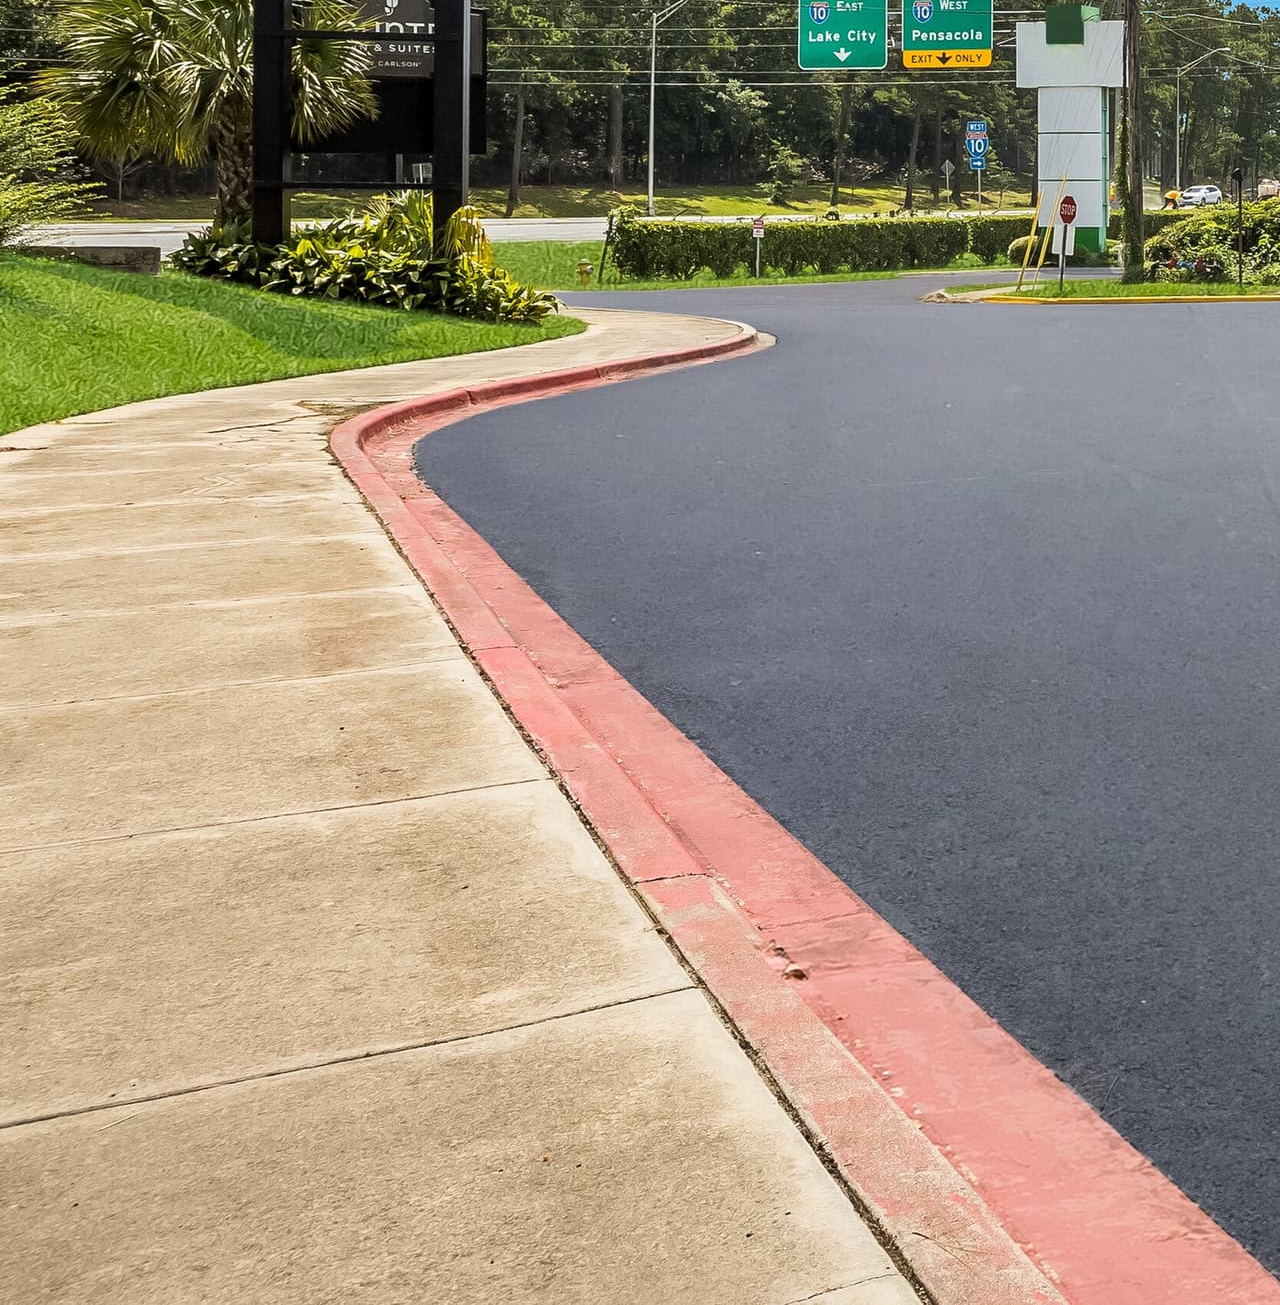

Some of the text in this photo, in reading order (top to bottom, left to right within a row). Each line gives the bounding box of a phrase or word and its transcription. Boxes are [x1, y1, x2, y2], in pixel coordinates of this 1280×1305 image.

[812, 7, 826, 20] 10
[916, 6, 930, 19] 10
[808, 30, 876, 44] Lake City
[912, 29, 983, 41] Pensacola
[911, 54, 983, 64] EXIT ONLY
[970, 139, 984, 153] 10
[1061, 203, 1076, 215] STOP
